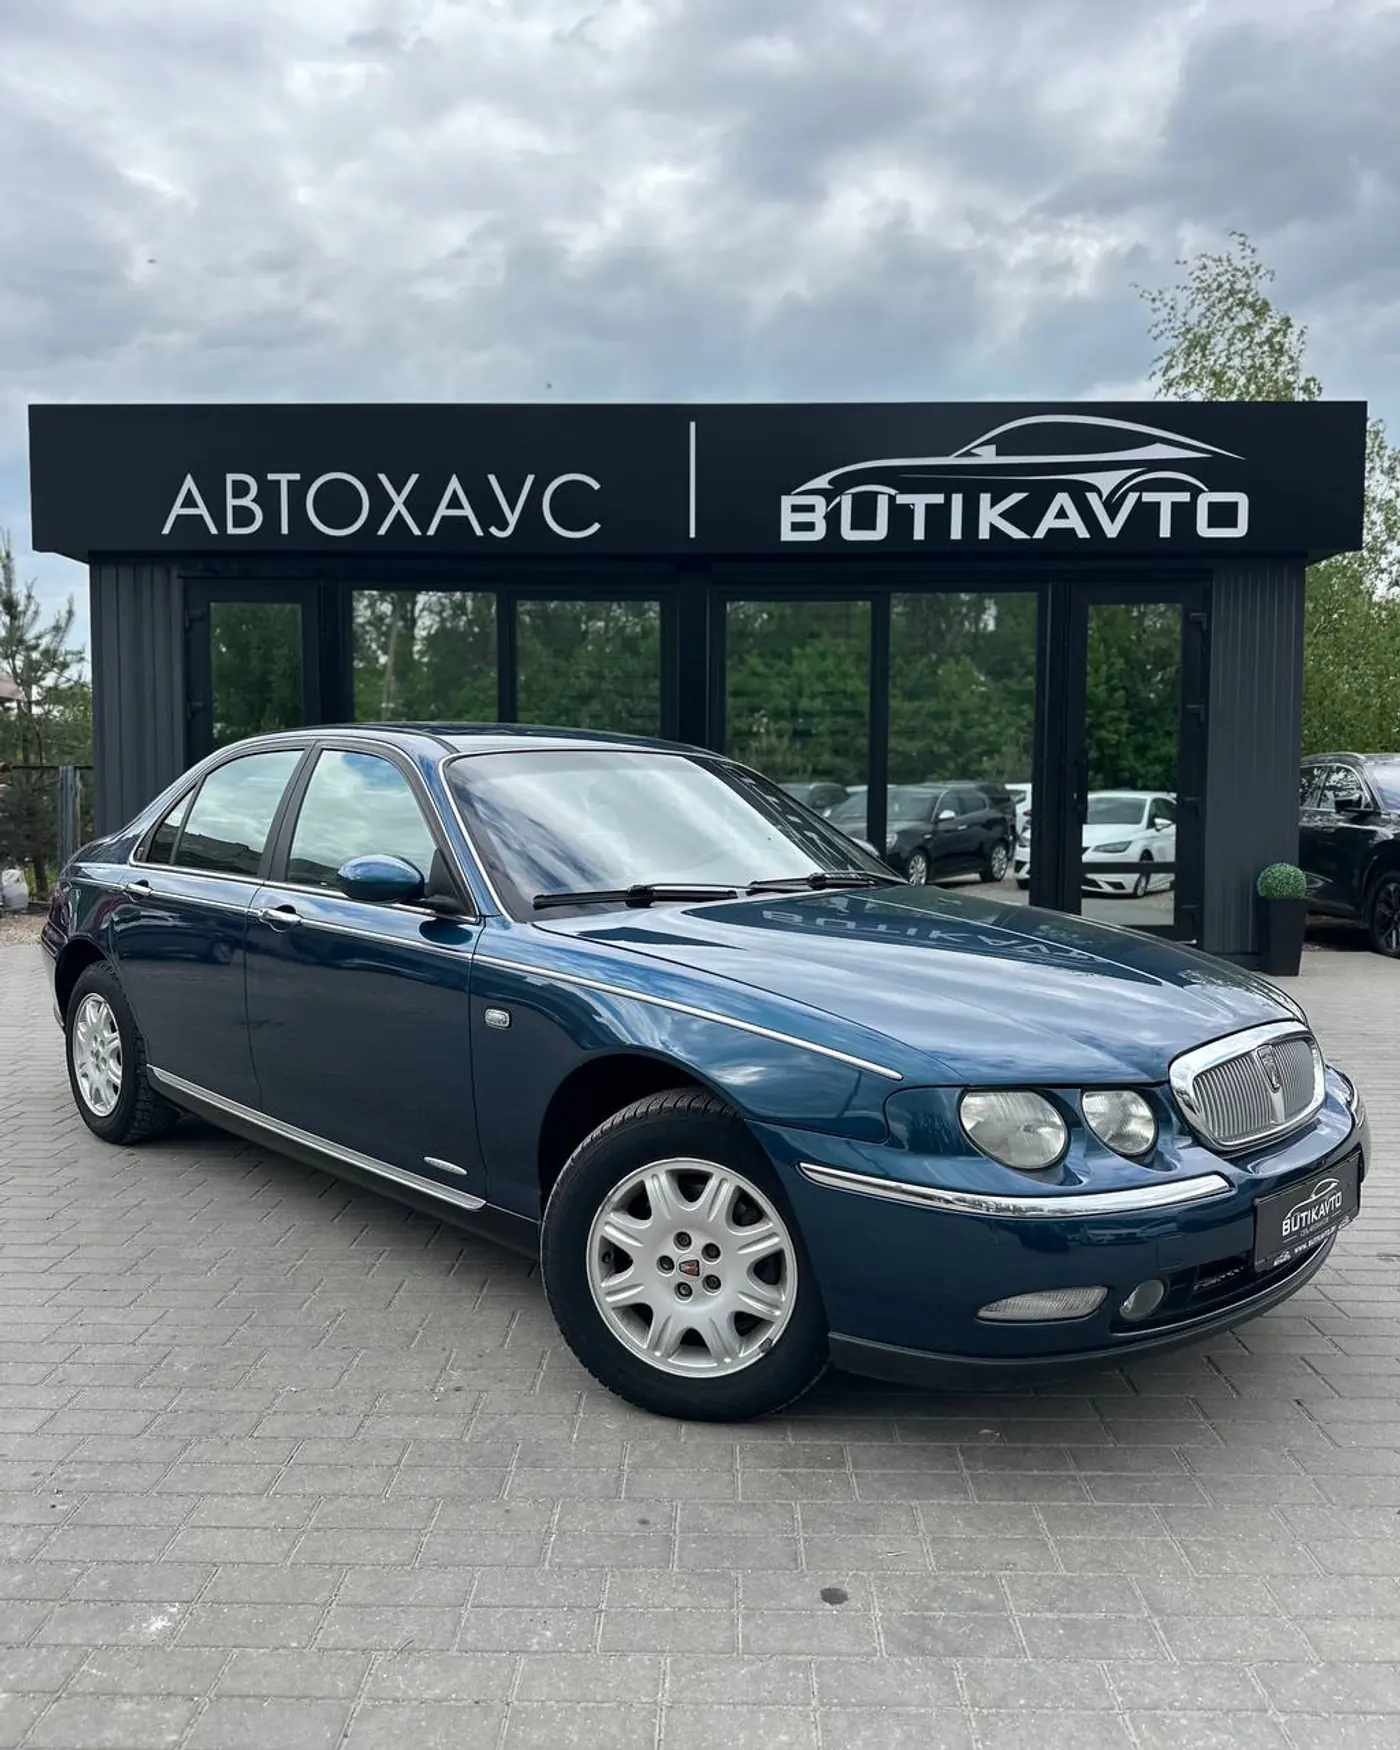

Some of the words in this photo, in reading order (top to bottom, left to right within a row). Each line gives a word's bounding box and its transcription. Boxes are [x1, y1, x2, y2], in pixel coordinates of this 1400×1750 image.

[162, 472, 601, 539] АВТОХАУС
[780, 491, 1249, 542] BUTIKAVTO
[1282, 1191, 1343, 1237] BUTIKAVTO
